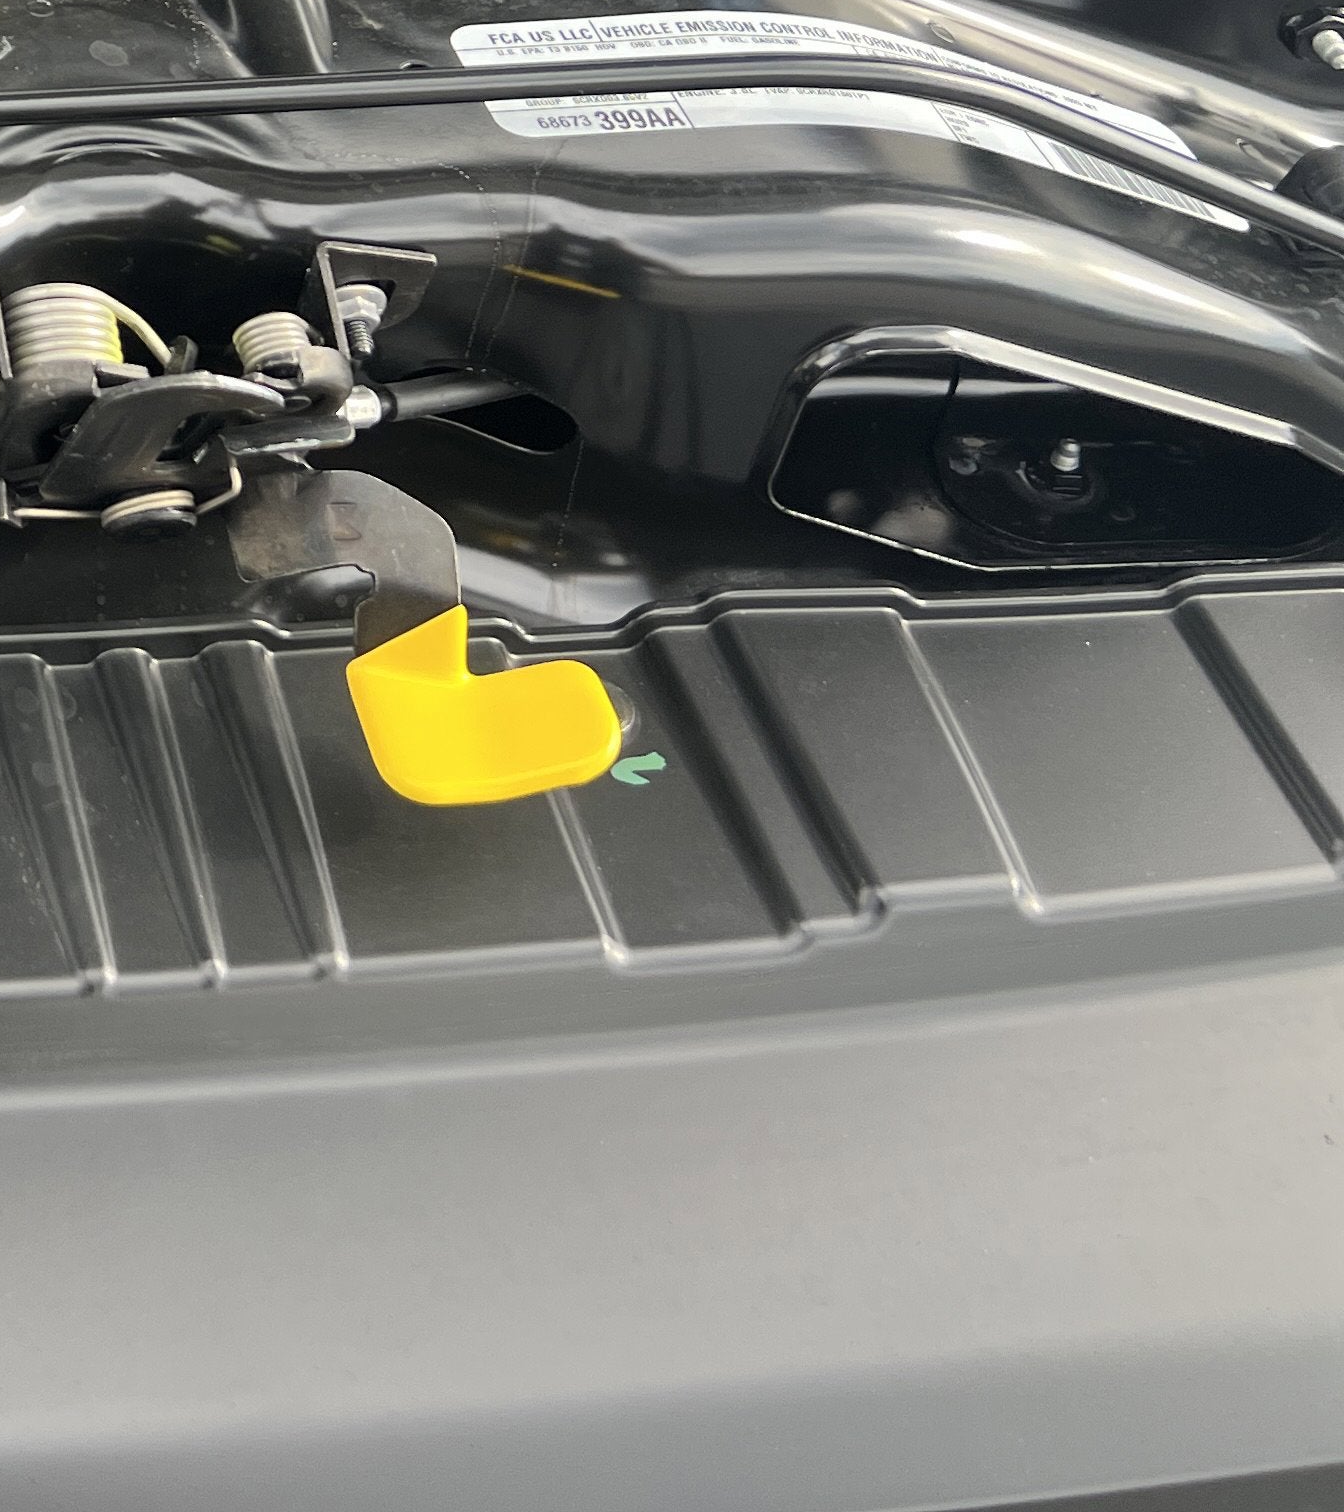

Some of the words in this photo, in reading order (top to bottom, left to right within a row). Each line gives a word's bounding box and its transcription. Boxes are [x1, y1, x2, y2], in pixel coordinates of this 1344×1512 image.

[488, 33, 526, 45] FCA
[529, 30, 555, 43] US
[559, 27, 593, 41] LLC
[600, 21, 672, 39] VEHICLE
[675, 20, 757, 34] EMISSION
[760, 21, 832, 39] CONTROL
[835, 29, 939, 65] INFORMATION
[537, 113, 592, 130] 68673
[594, 106, 686, 131] 399AA
